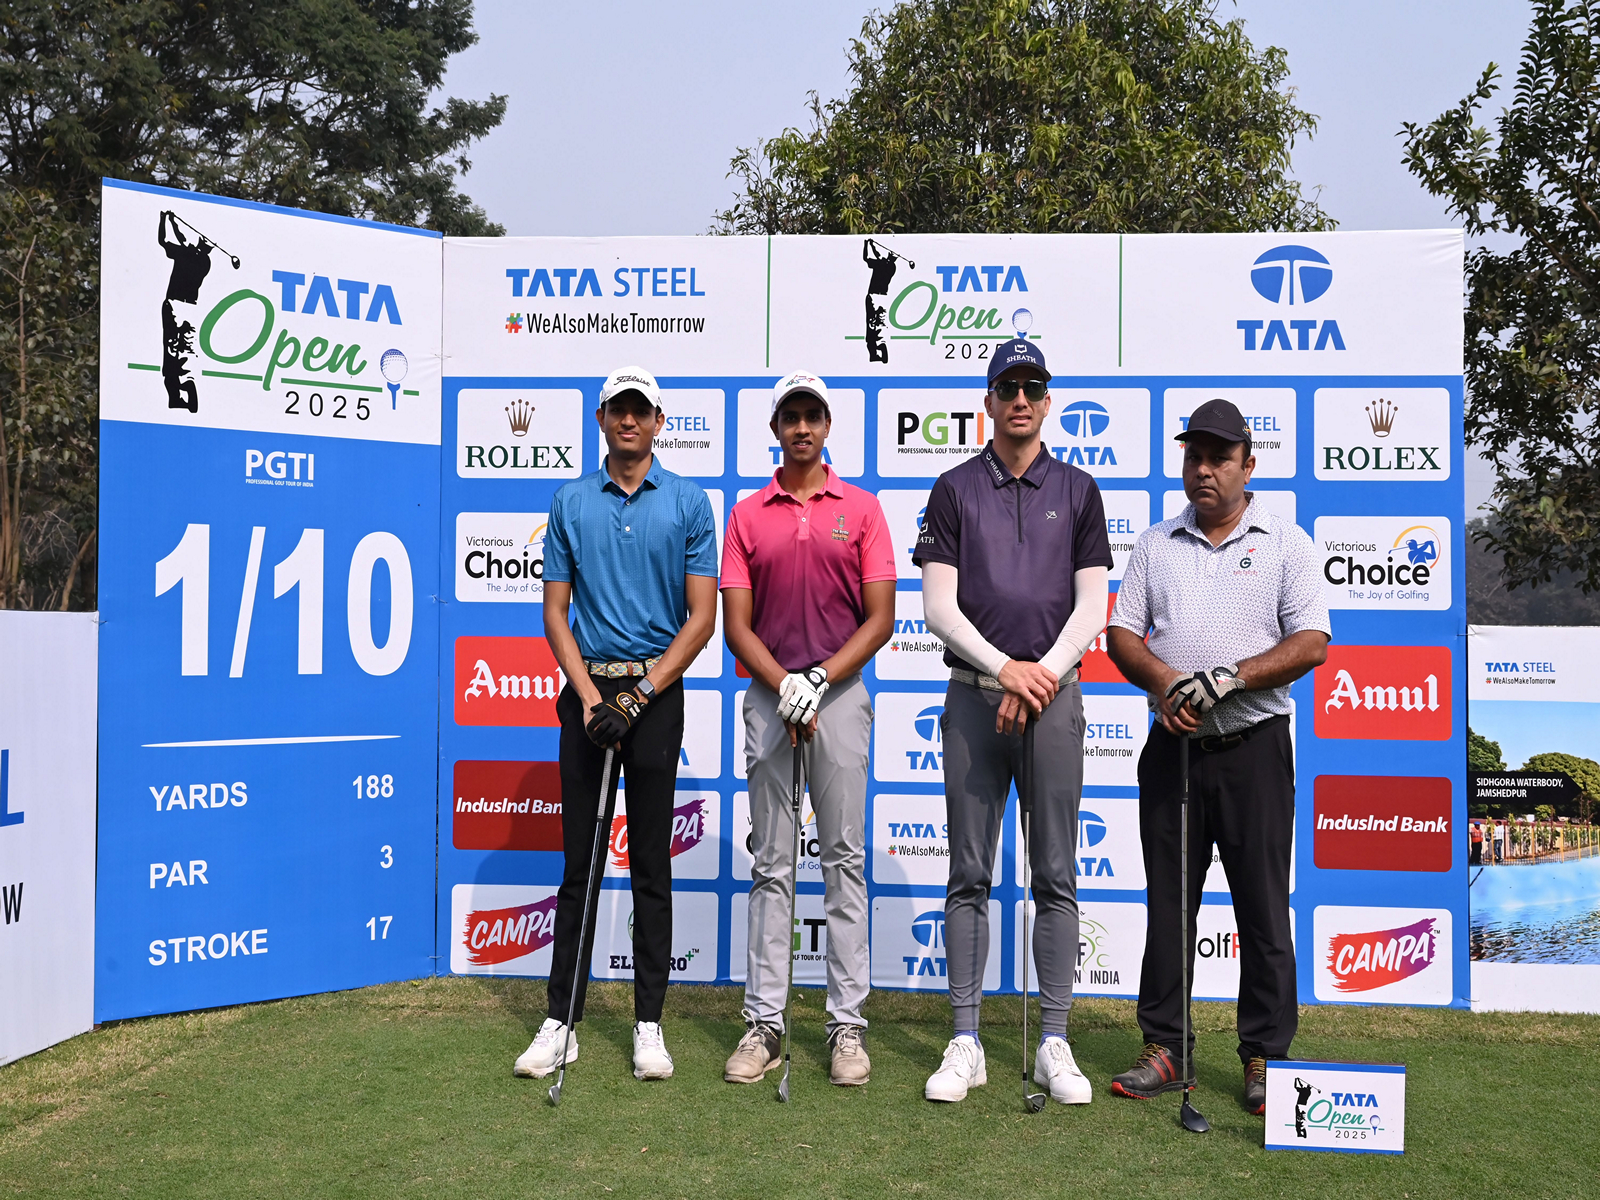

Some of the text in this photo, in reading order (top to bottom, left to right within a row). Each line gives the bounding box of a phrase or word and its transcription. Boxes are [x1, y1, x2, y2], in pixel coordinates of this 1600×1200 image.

[506, 267, 706, 297] TATA STEEL
[936, 266, 1029, 292] TATA
[272, 270, 402, 325] TATA
[505, 313, 705, 334] #WeAlsoMakeTomorrow
[888, 281, 1003, 346] Open
[199, 289, 367, 391] Open
[1236, 320, 1347, 351] TATA
[944, 343, 1005, 360] 202
[1006, 354, 1037, 363] SHEATH
[285, 391, 371, 420] 2025
[665, 416, 711, 432] STEEL
[897, 412, 985, 446] PGTI
[1243, 416, 1281, 432] TEEL
[653, 438, 711, 449] MakeTomorrow
[245, 449, 315, 481] PGTI
[465, 445, 574, 468] ROLEX
[1052, 446, 1118, 466] TATA
[1322, 446, 1441, 470] ROLEX
[1107, 518, 1135, 534] EEL
[466, 536, 514, 547] Victorious
[1325, 541, 1377, 552] Victorious
[464, 550, 544, 579] Choic
[1324, 556, 1430, 586] Choice
[486, 582, 502, 593] The
[503, 583, 519, 594] Joy
[519, 583, 530, 593] of
[1348, 590, 1430, 602] The Joy of Golfing
[155, 523, 414, 678] 1/10
[894, 619, 930, 634] TAT
[1485, 662, 1556, 673] TATA STEEL
[1485, 677, 1556, 685] #WeAlsoMakeTomorrow
[1325, 669, 1440, 715] Amul
[1086, 723, 1134, 739] STEEL
[352, 774, 394, 800] 188
[1476, 777, 1564, 789] SIDHGORA WATERBODY,
[1476, 788, 1527, 798] JAMSHEDPUR
[149, 782, 248, 812] YARDS
[455, 797, 563, 815] IndusInd Ban
[614, 812, 700, 854] CPA
[888, 823, 937, 839] TATA
[1316, 813, 1448, 834] IndusInd Bank
[379, 845, 394, 869] 3
[888, 844, 950, 857] #WeAlsoMake
[149, 860, 209, 889] PAR
[797, 861, 806, 870] of
[365, 916, 394, 941] 17
[470, 907, 557, 951] CAMPA
[148, 929, 269, 966] STROKE
[1335, 931, 1431, 976] CAMPA
[902, 956, 947, 977] TAT
[1090, 969, 1120, 985] INDIA
[1331, 1092, 1379, 1107] TATA
[1307, 1099, 1365, 1131] Open
[1335, 1130, 1367, 1140] 2025
